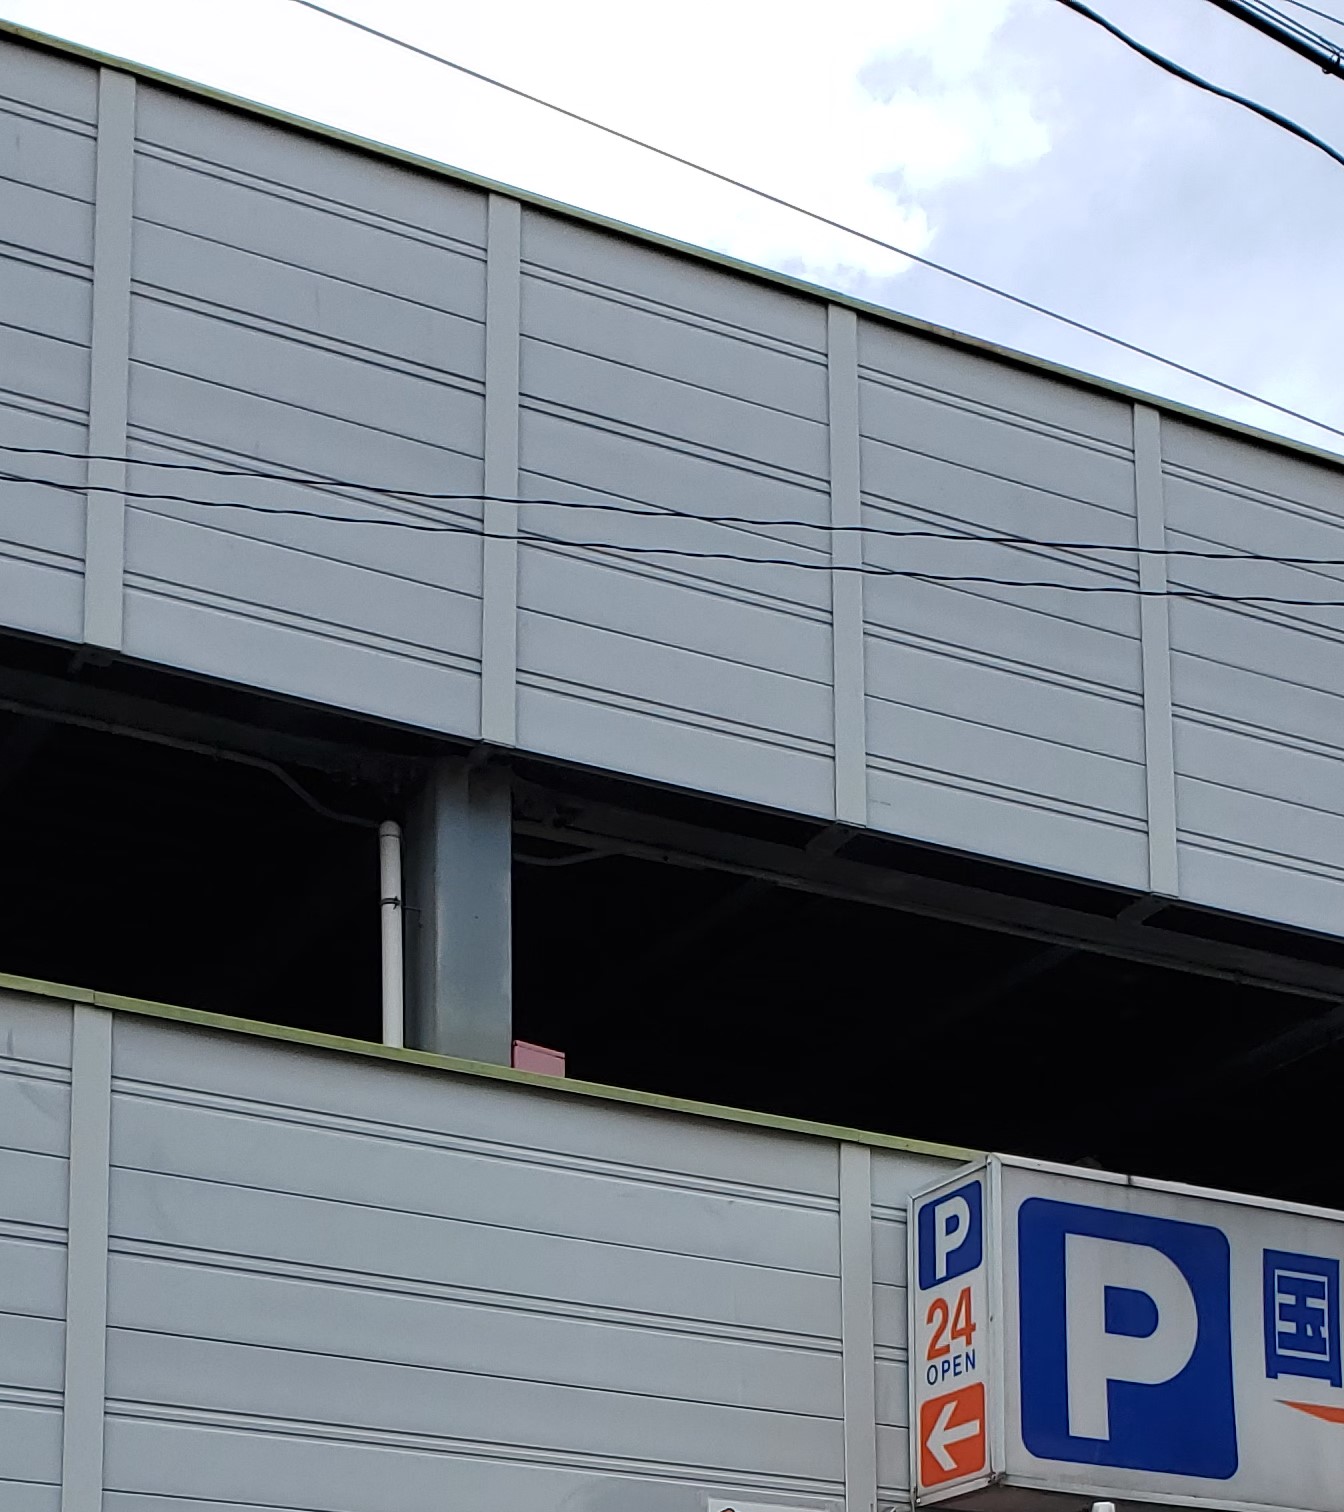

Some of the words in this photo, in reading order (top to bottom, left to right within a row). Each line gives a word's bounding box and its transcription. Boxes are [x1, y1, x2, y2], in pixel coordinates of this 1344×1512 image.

[932, 1194, 970, 1278] P
[925, 1287, 978, 1360] 24
[1065, 1232, 1199, 1442] P
[926, 1349, 978, 1385] OPEN
